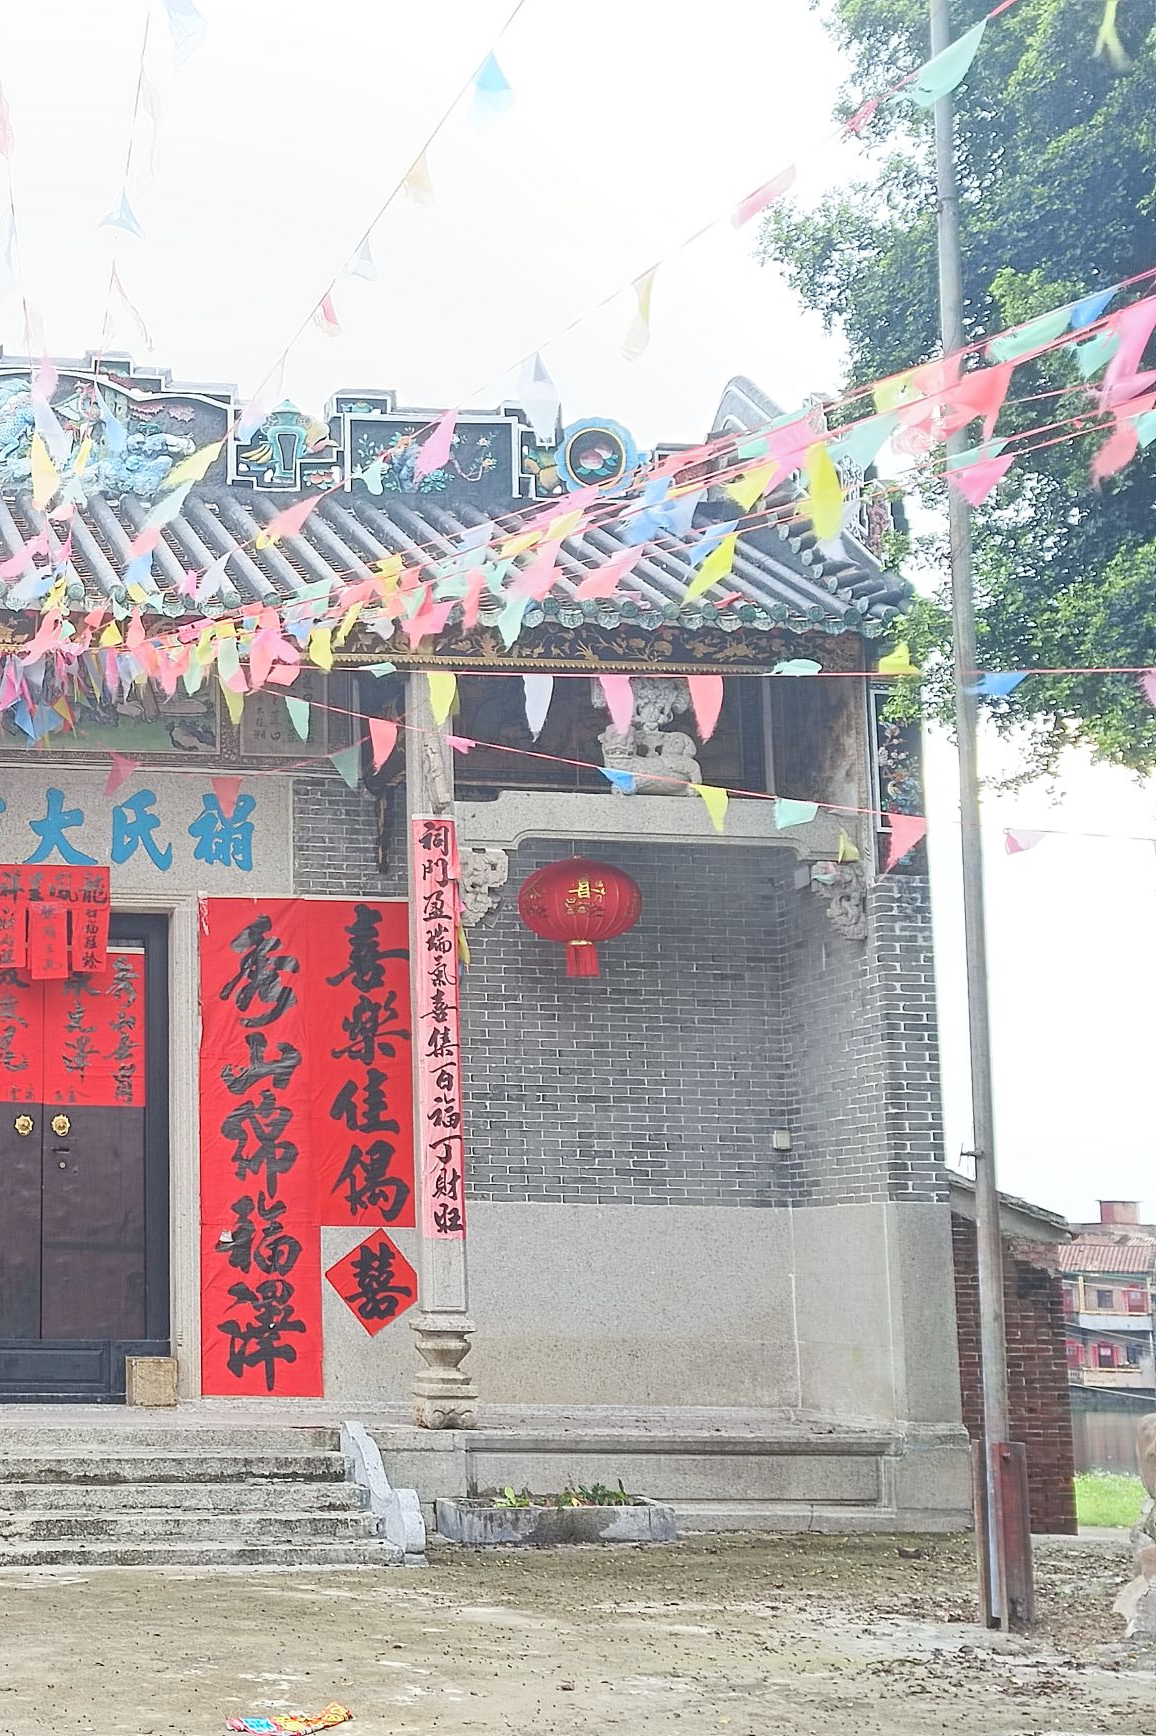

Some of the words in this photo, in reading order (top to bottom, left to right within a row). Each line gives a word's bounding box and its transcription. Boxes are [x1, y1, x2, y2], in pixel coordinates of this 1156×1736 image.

[325, 904, 411, 1222] 喜樂佳偶
[345, 1242, 412, 1320] 囍
